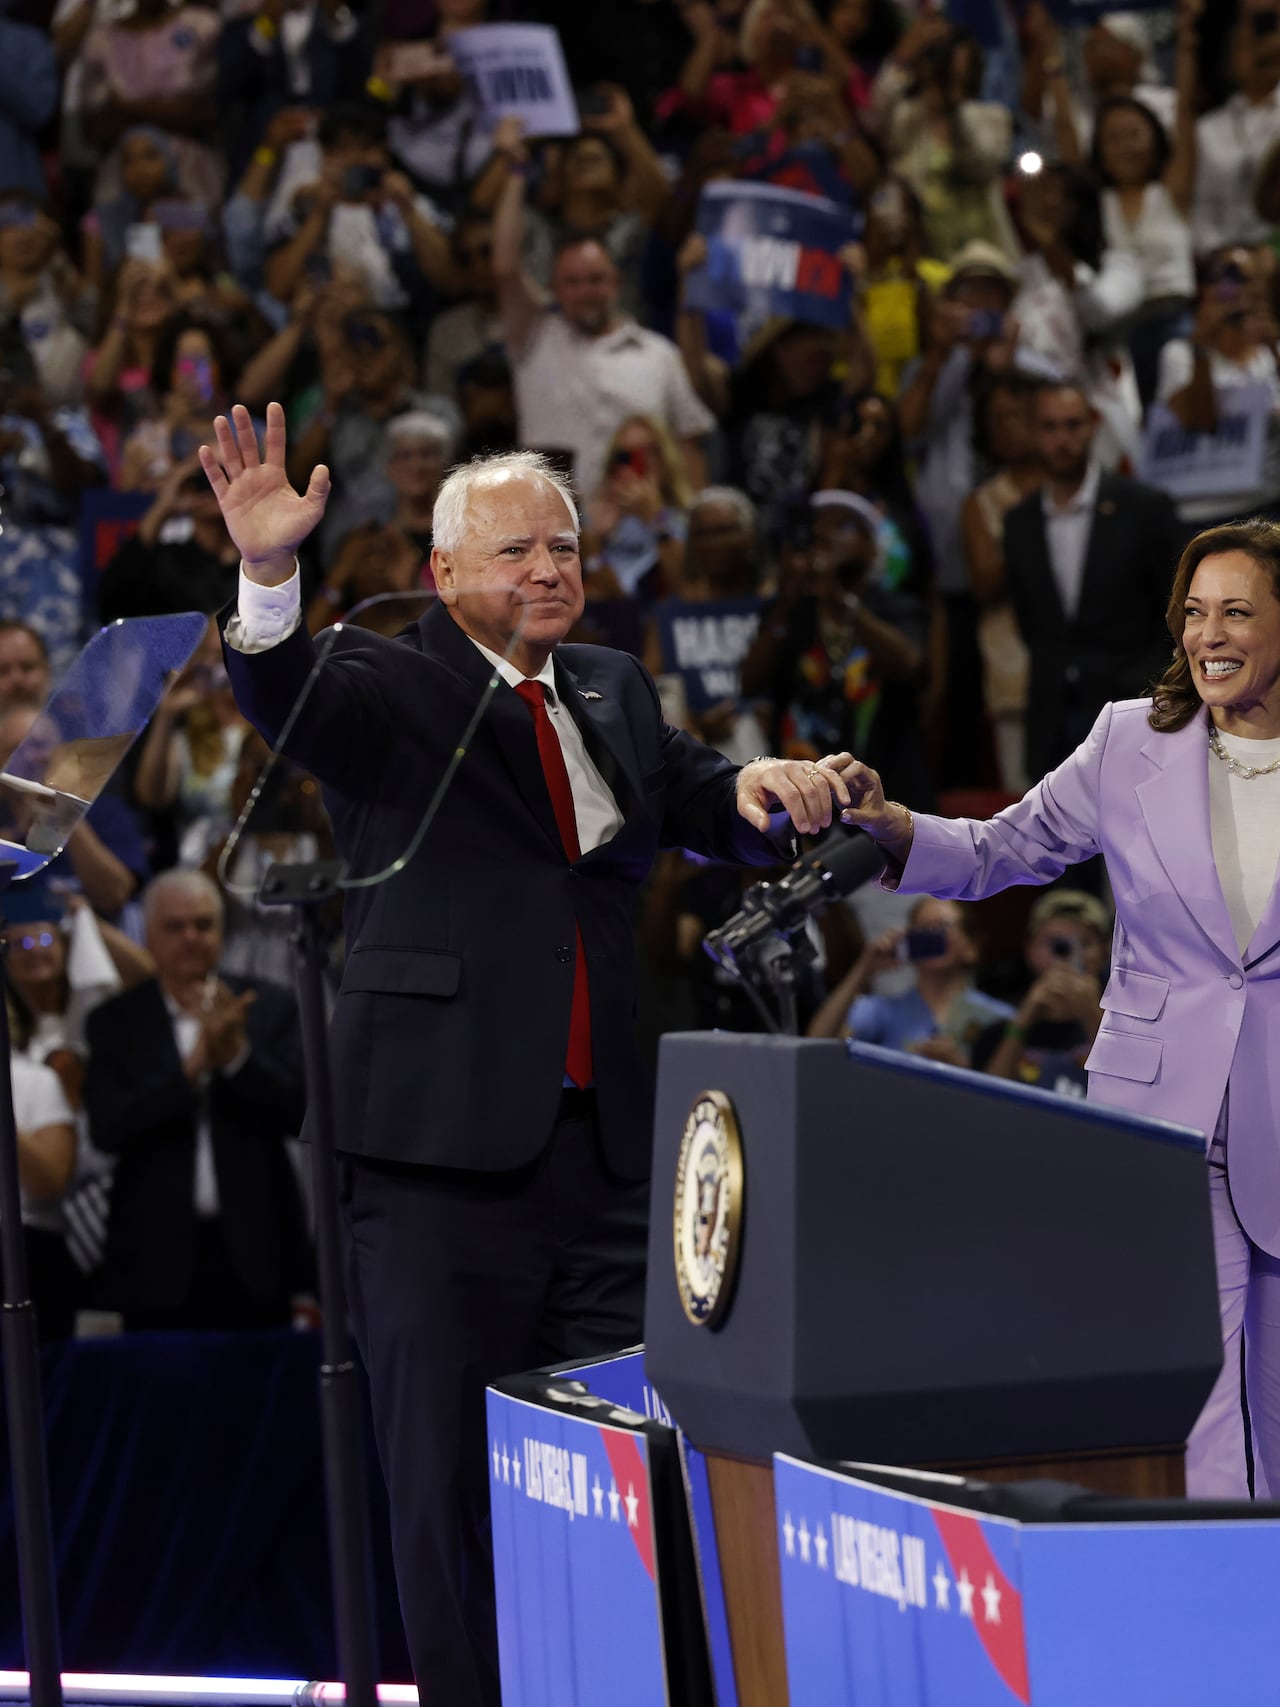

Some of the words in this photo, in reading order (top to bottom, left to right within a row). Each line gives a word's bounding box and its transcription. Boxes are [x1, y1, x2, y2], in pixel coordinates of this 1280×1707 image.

[523, 1437, 544, 1502] LAS
[831, 1511, 860, 1587] LAS
[901, 1533, 928, 1610] NV
